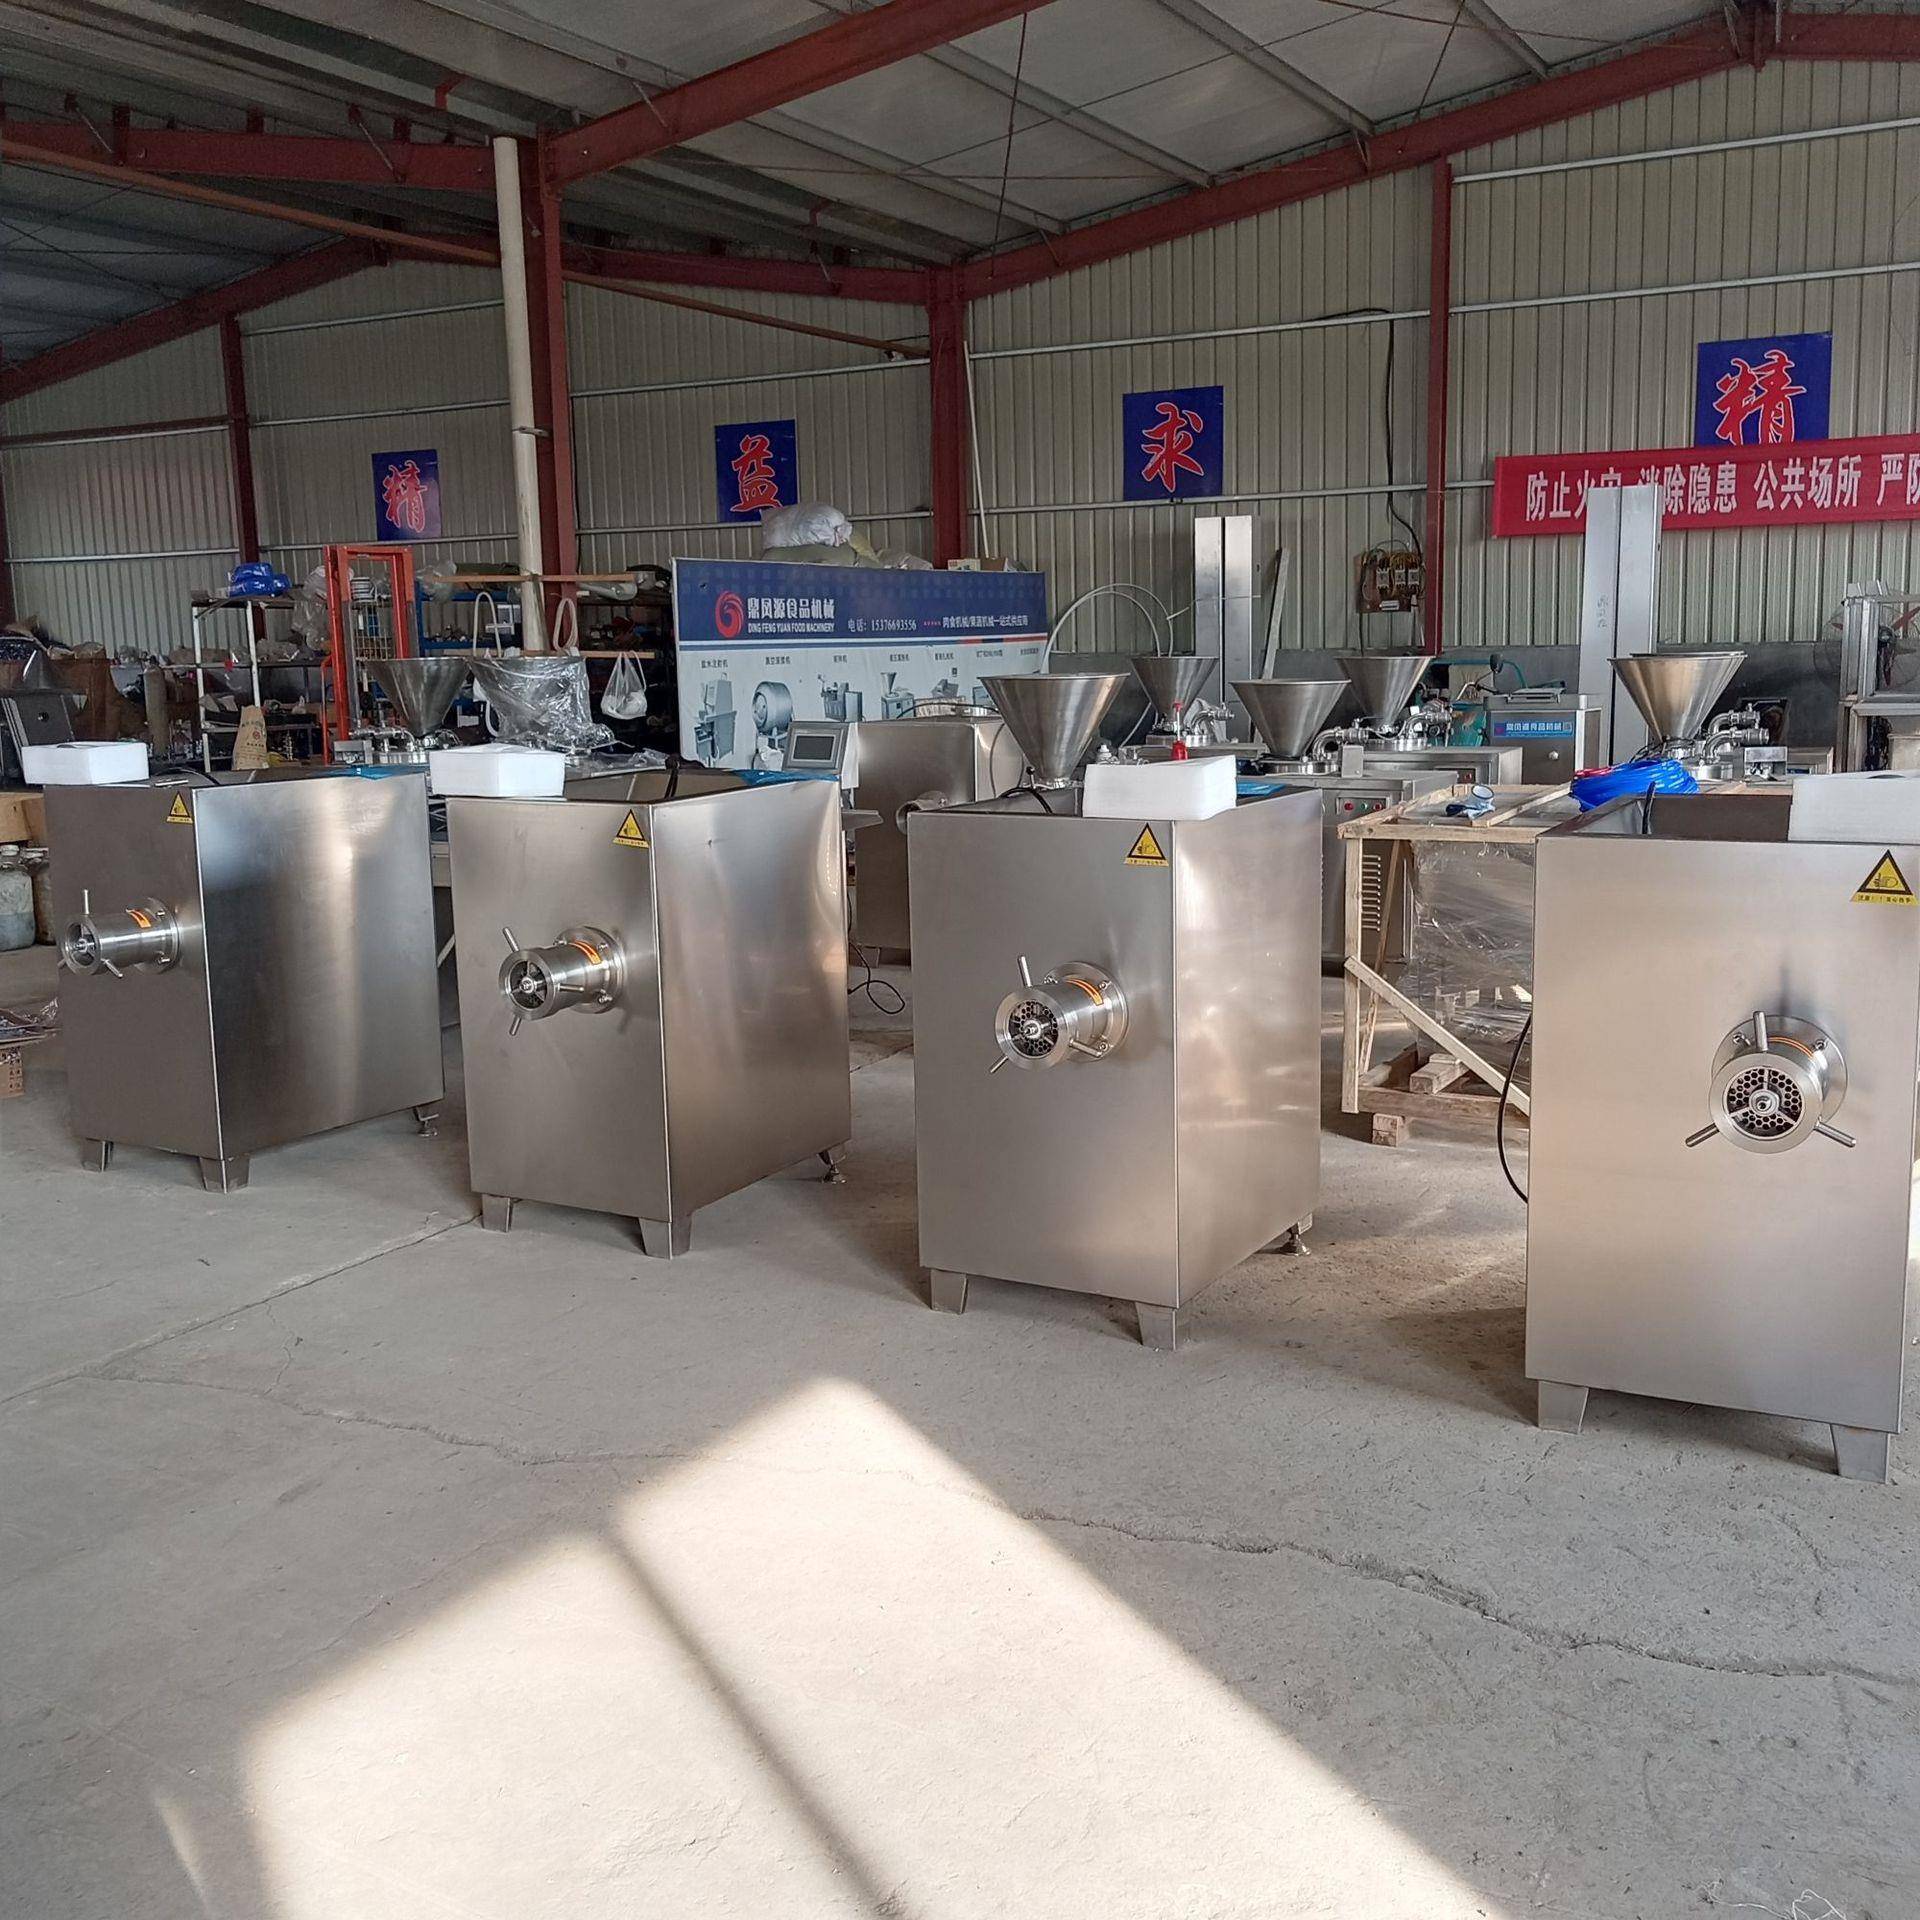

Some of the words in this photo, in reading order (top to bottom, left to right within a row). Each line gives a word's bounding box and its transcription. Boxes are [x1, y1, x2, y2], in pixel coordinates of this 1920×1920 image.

[1714, 348, 1806, 445] 精
[730, 435, 784, 513] 益
[1141, 402, 1205, 493] 求
[1753, 454, 1862, 511] 公共场所
[382, 459, 428, 534] 精
[748, 623, 761, 633] DING
[762, 623, 776, 633] FENG
[777, 623, 791, 633] YUAN
[792, 623, 805, 633] FOOD
[806, 622, 835, 632] MACHINERY
